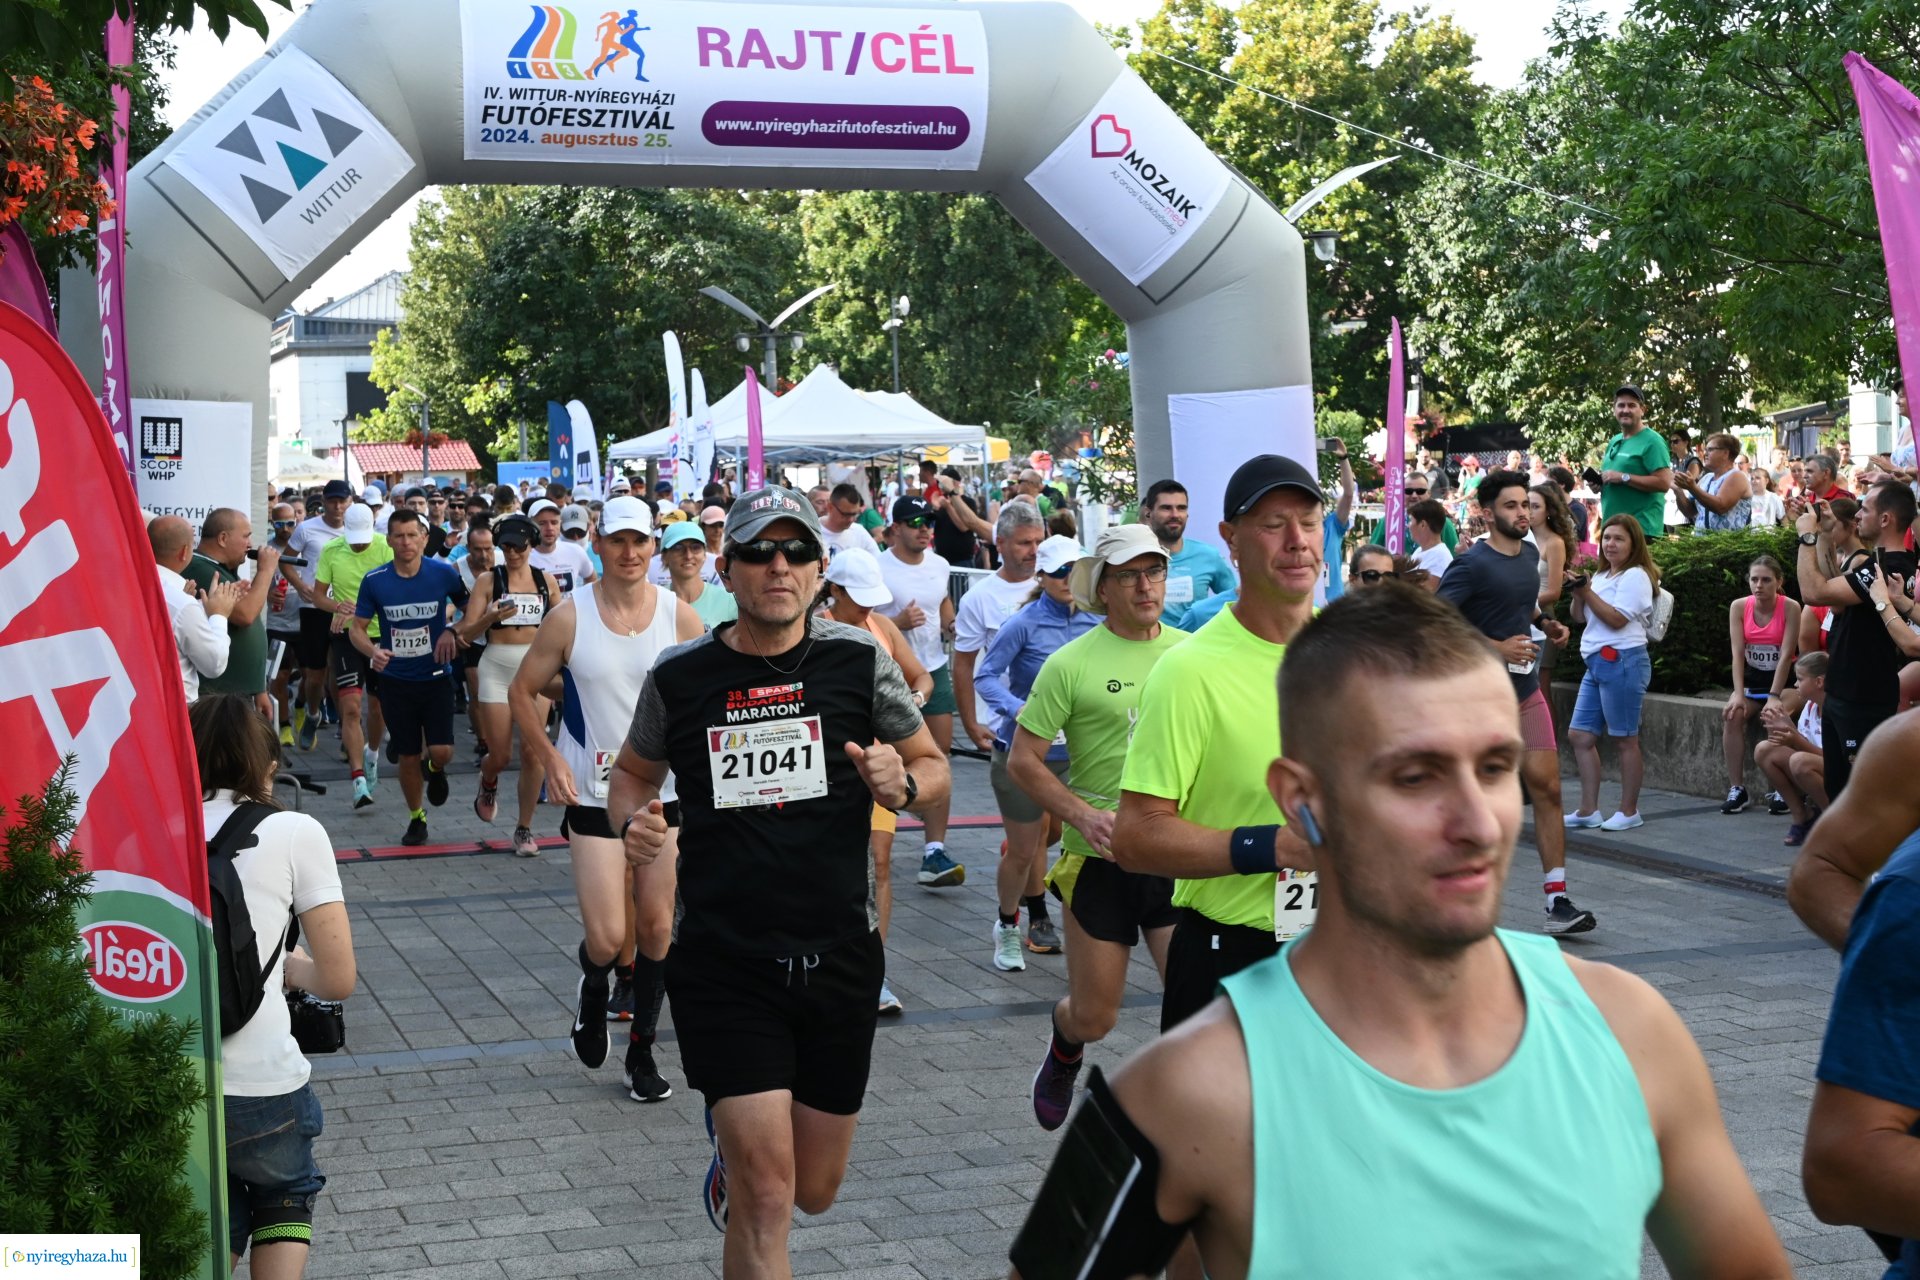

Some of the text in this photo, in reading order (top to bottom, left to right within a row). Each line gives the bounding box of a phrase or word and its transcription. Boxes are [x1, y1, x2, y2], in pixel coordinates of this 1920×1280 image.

[697, 24, 975, 76] RAJT/CÉL
[483, 86, 676, 106] IV. WITTUR-NYÍREGYHÁZI
[481, 101, 676, 130] FUTÓFESZTIVÁL
[715, 117, 957, 136] www.nyiregyhazifutofesztival.hu
[480, 128, 673, 148] 2024. augusztus 25.
[1110, 170, 1121, 181] Az
[1118, 178, 1140, 198] orvosi
[1124, 149, 1197, 220] MOZAIK
[300, 167, 363, 226] WITTUR
[1163, 206, 1187, 228] med
[140, 459, 183, 470] SCOPE
[148, 471, 176, 481] WHP
[395, 635, 428, 648] 21126
[1747, 650, 1779, 662] 10018
[726, 690, 804, 710] BUDAPEST
[727, 685, 790, 701] 38. SPAR
[726, 702, 801, 723] MARATON
[721, 744, 812, 780] 21041
